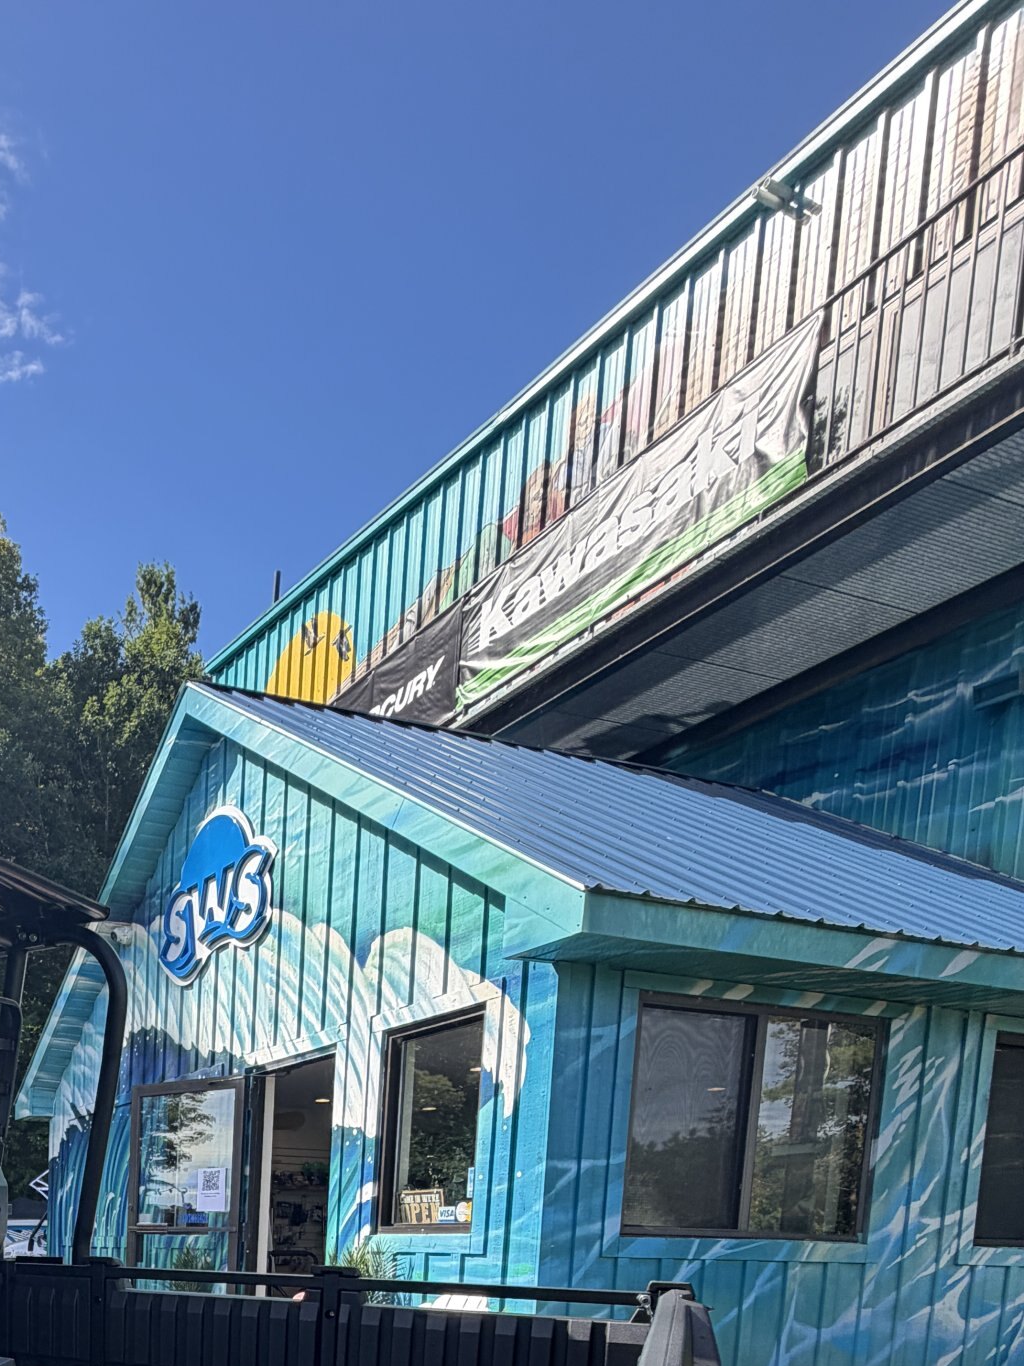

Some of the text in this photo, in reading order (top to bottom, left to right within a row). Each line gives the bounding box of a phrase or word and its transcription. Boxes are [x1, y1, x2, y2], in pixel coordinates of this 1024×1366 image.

[477, 394, 761, 649] Kawasaki
[369, 655, 446, 717] CURY
[159, 843, 273, 978] SWS
[400, 1202, 440, 1224] OPEN
[439, 1209, 454, 1218] VISA
